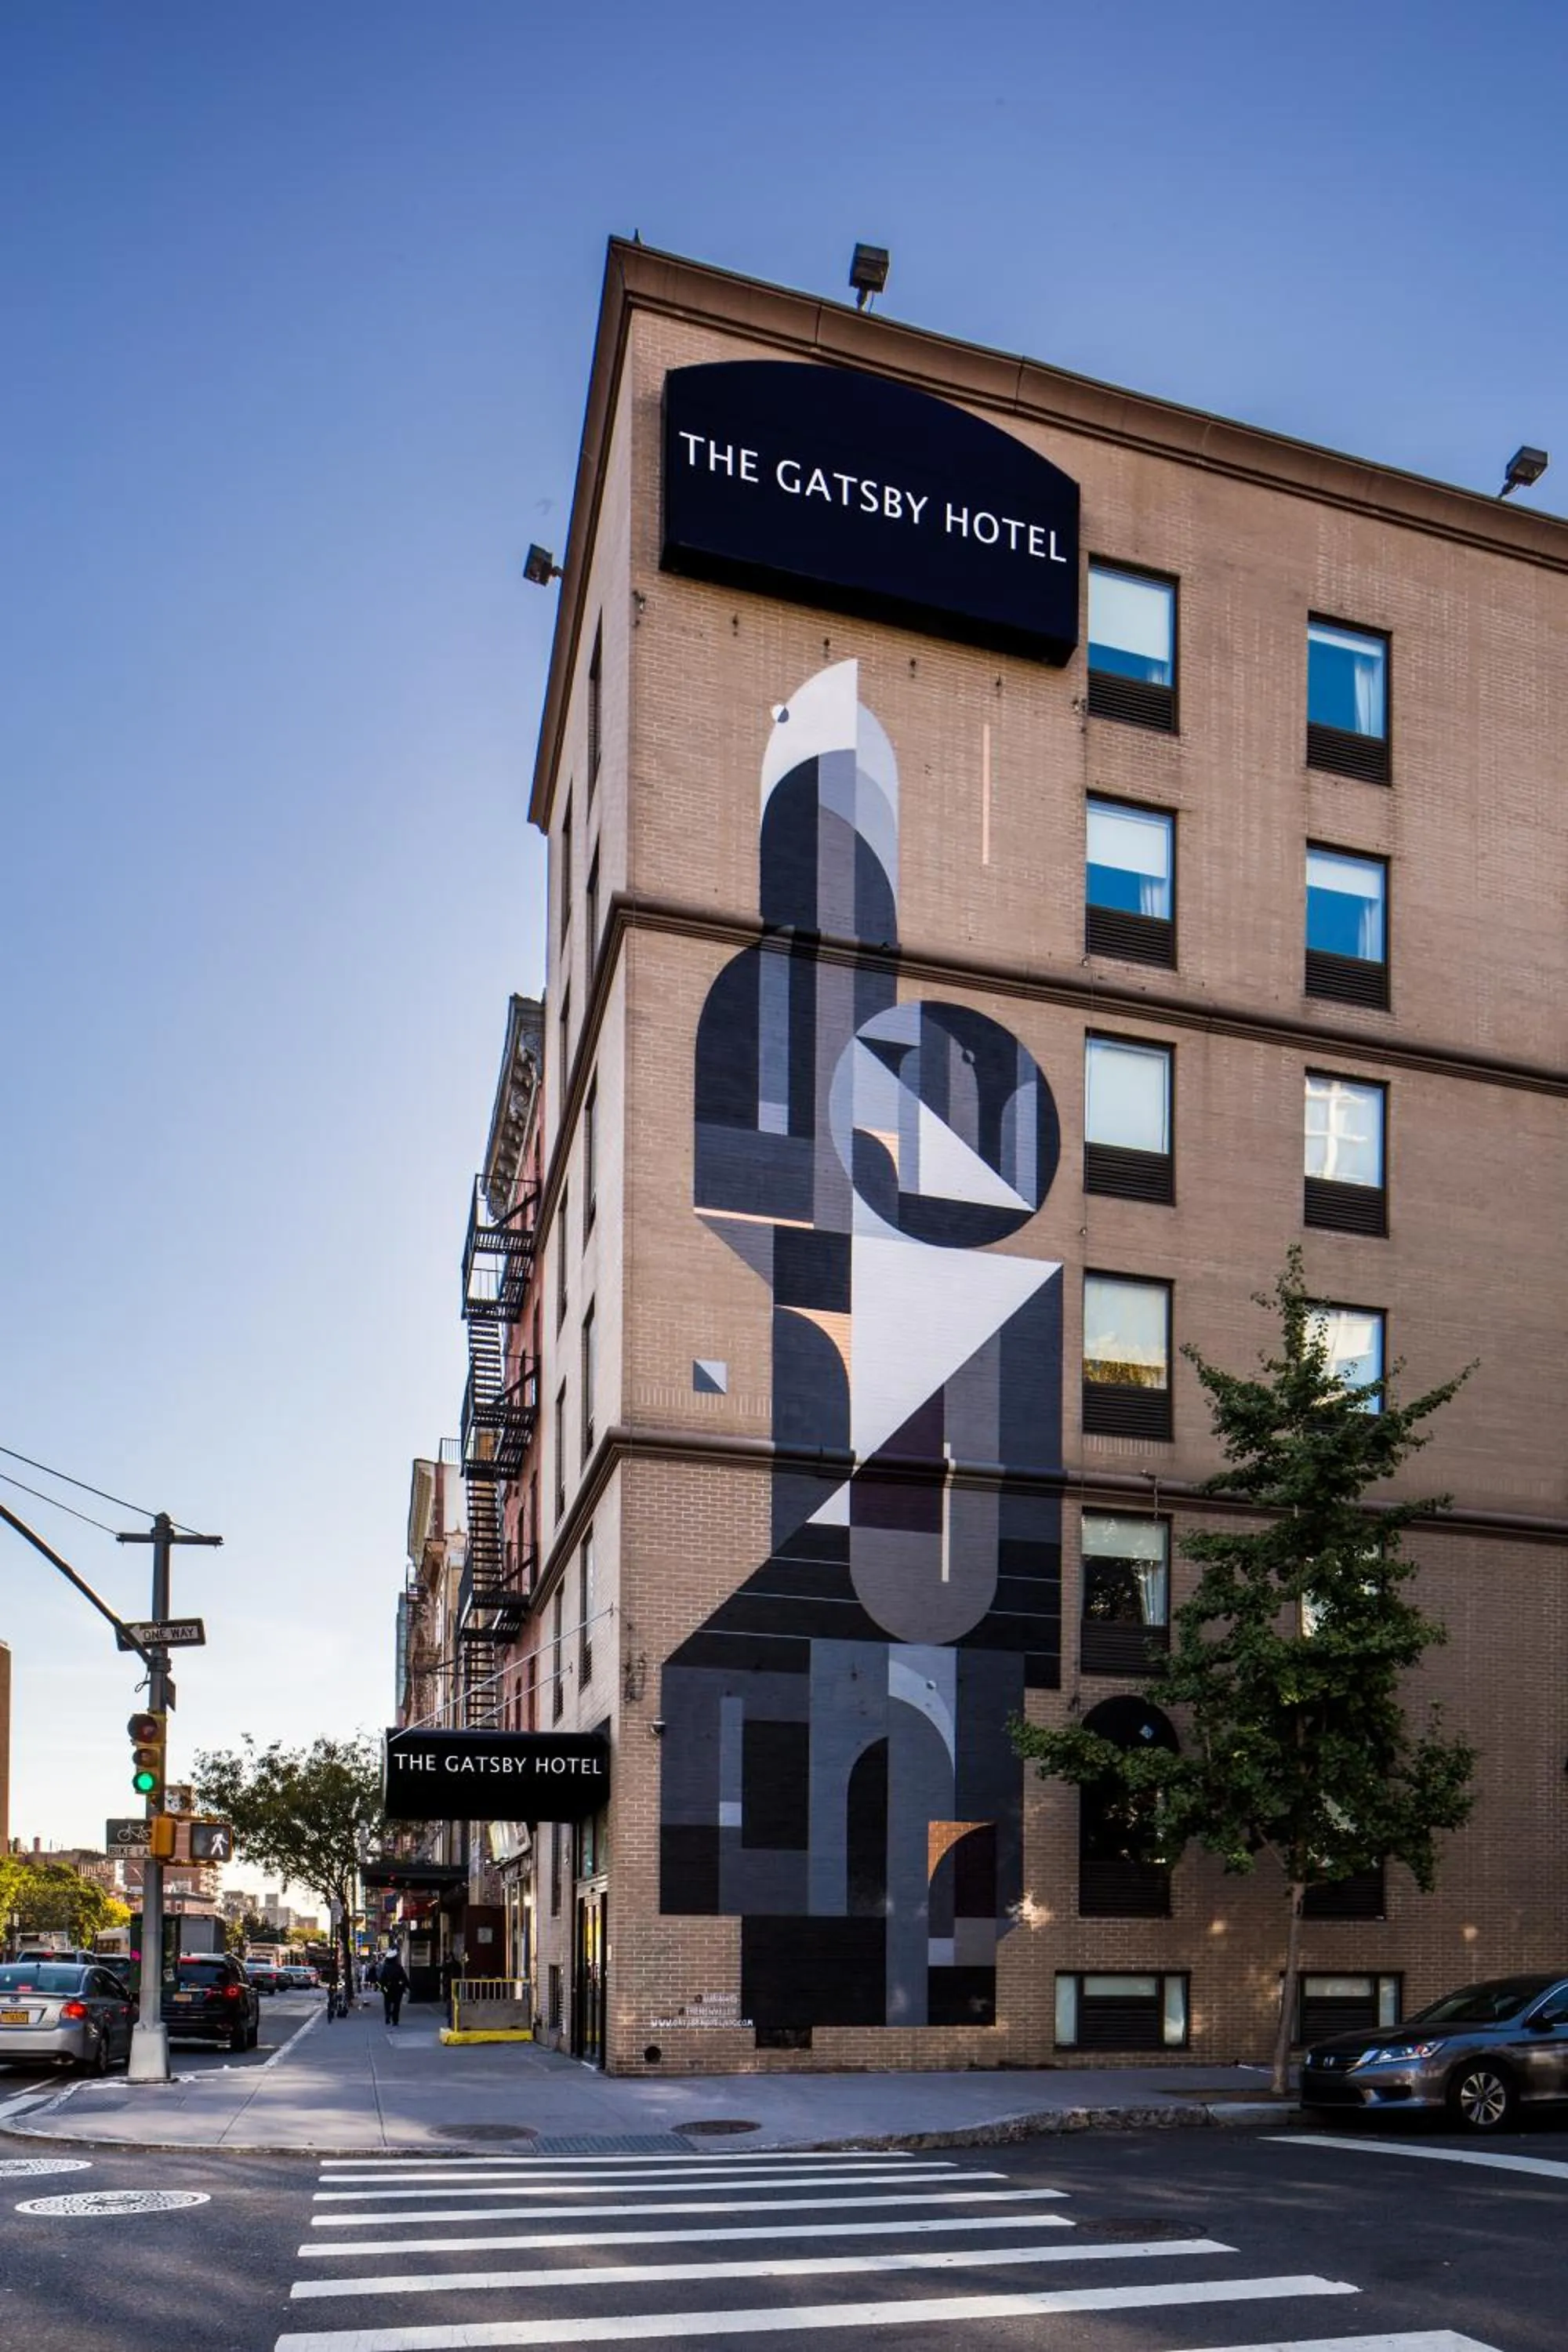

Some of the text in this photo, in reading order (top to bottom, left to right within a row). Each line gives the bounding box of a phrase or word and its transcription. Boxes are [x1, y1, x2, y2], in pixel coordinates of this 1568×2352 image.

[679, 431, 1067, 563] THE GATSBY HOTEL
[143, 1628, 194, 1641] ONE WAY
[394, 1753, 602, 1774] THE GATSBY HOTEL
[108, 1846, 151, 1857] BIKE LA
